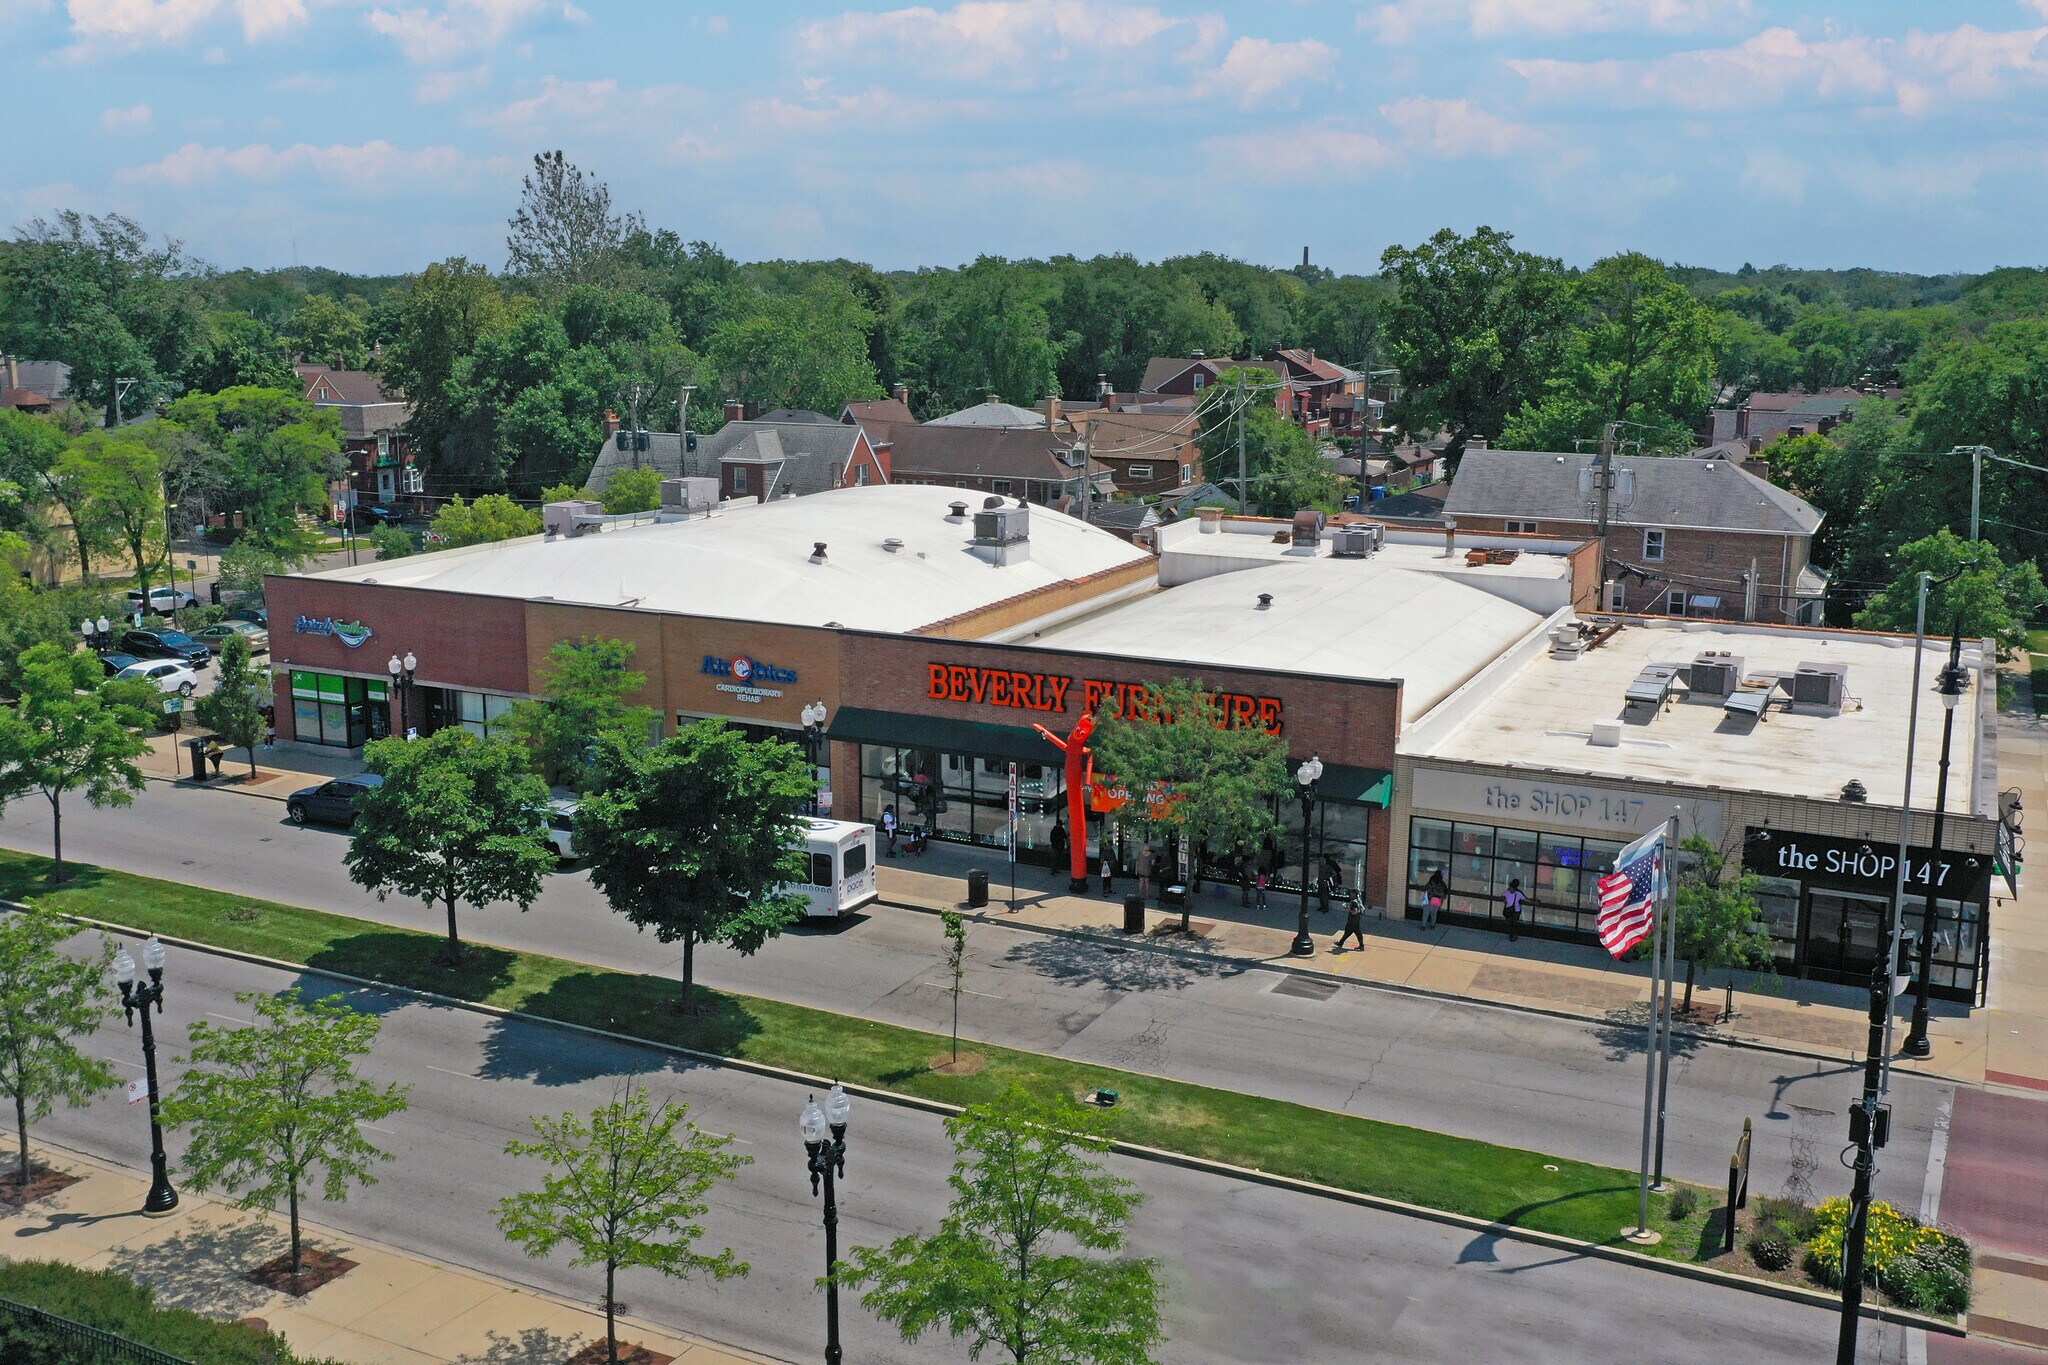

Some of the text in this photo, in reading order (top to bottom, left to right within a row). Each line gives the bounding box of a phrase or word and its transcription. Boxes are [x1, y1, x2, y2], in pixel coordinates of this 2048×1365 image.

[716, 684, 782, 698] CARDIOPULMONARY
[737, 694, 761, 704] REHAB
[928, 663, 1282, 737] BEVERLY FURNURE
[1107, 787, 1165, 805] OPENG
[1485, 785, 1643, 826] the SHOP 147
[1778, 843, 1951, 887] the SHOP 147
[847, 879, 863, 893] pace
